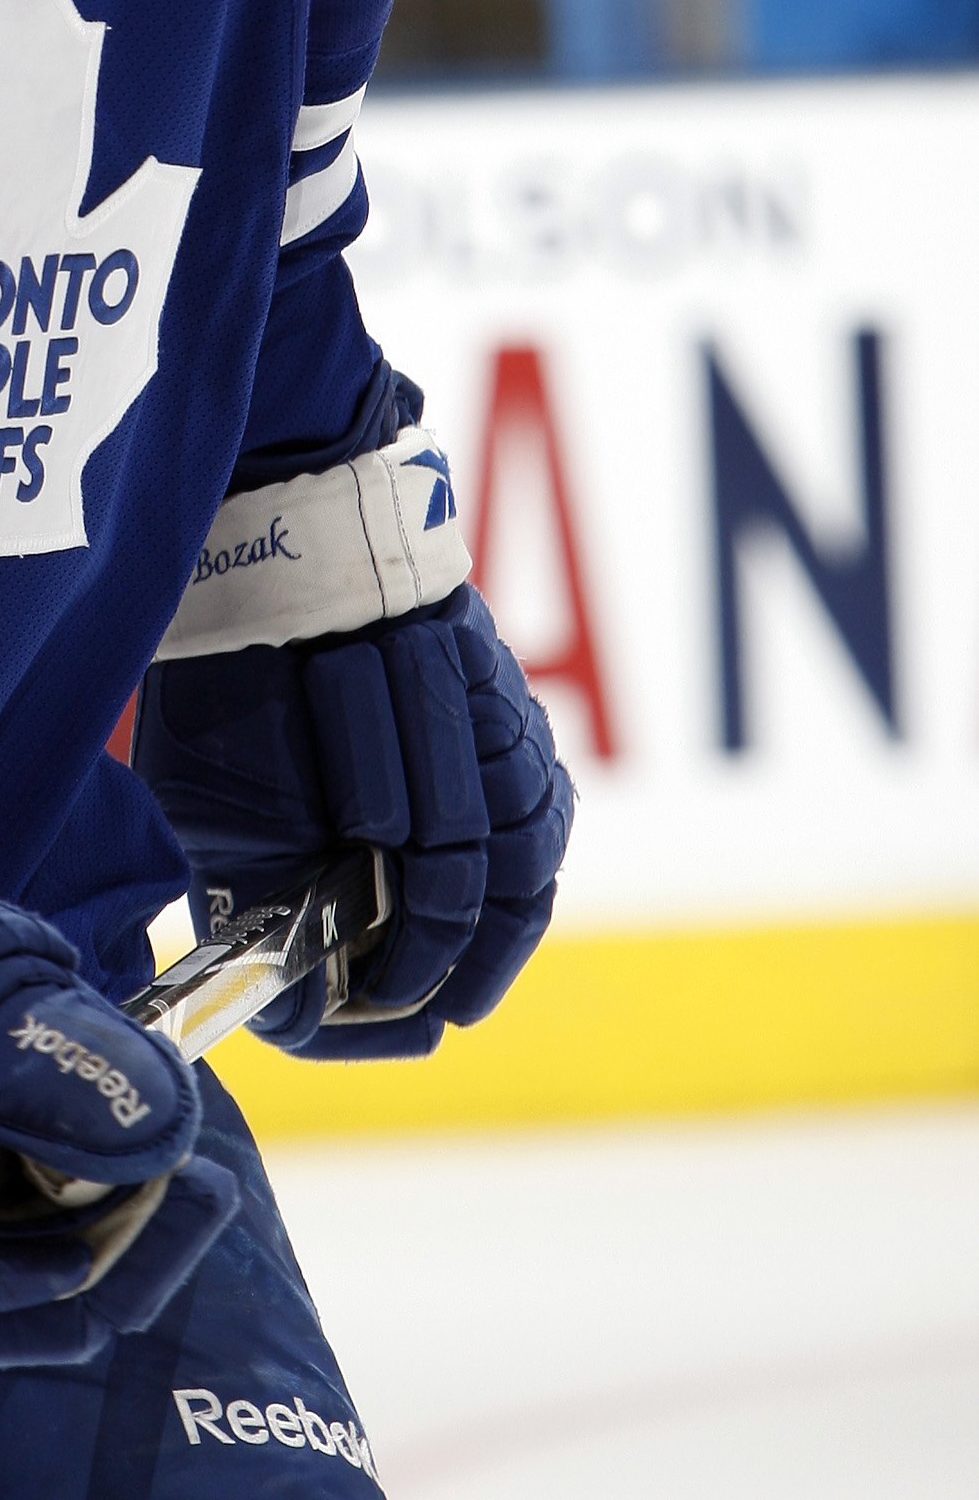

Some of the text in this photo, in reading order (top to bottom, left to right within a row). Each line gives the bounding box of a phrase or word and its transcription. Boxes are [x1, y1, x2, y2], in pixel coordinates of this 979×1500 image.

[193, 516, 302, 585] Bozak
[462, 318, 979, 770] AN
[6, 1013, 152, 1129] Reebok
